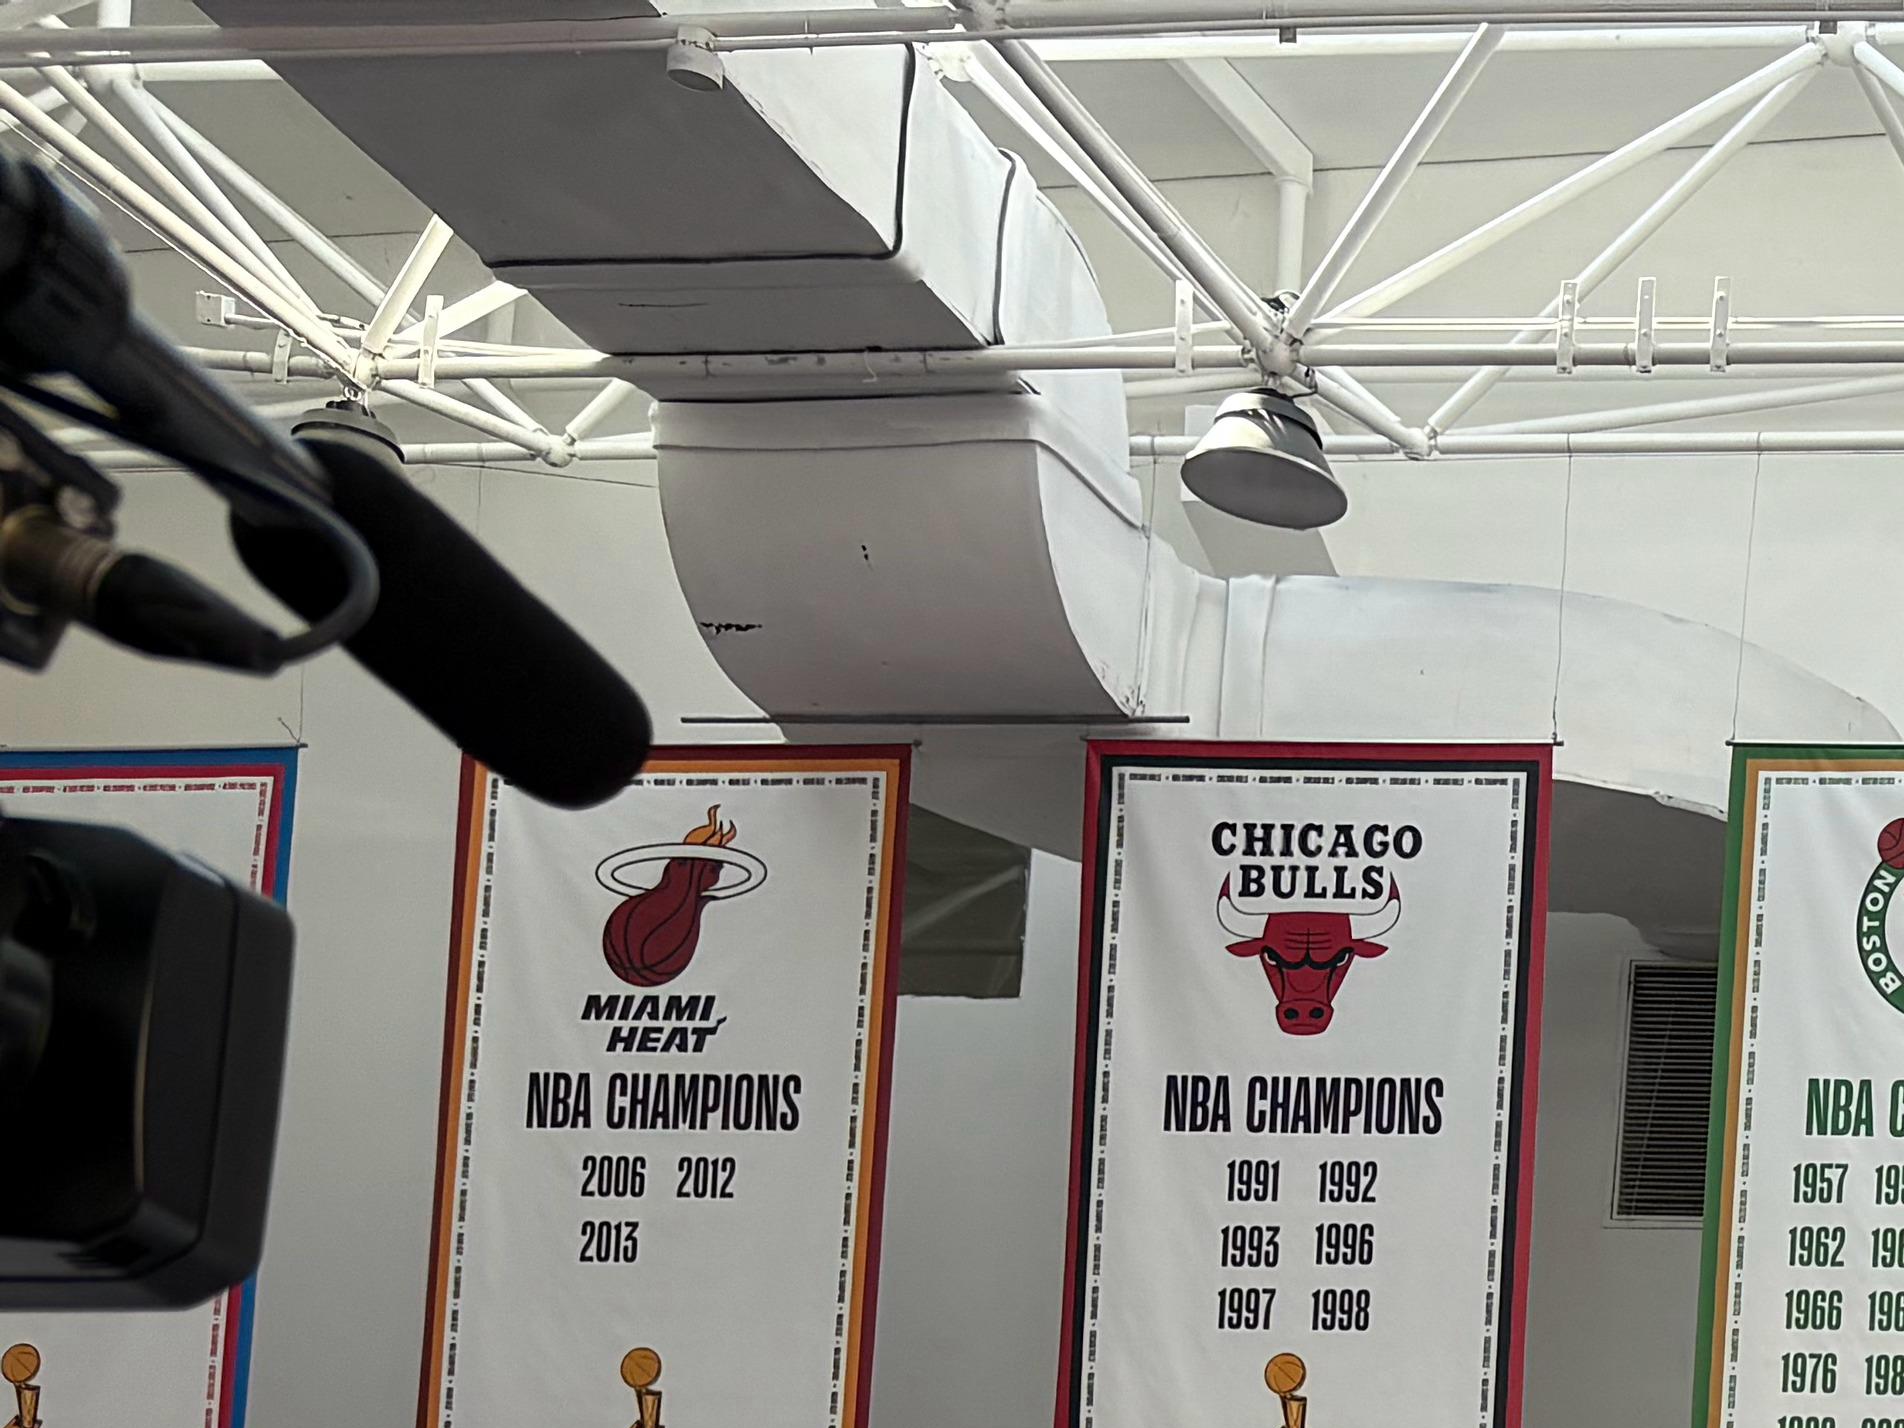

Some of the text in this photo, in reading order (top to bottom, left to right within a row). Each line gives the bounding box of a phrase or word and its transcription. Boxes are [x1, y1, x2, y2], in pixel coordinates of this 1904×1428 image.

[1210, 821, 1423, 859] CHICAGO
[1237, 865, 1386, 900] BULLS
[1863, 868, 1900, 998] BOSTON
[581, 994, 717, 1022] MIAMI
[606, 1018, 727, 1053] HEAT
[525, 1071, 802, 1132] NBA CHAMPIONS
[1163, 1074, 1444, 1135] NBA CHAMPIONS
[1805, 1077, 1874, 1138] NBA
[580, 1155, 736, 1199] 2006 2012
[1226, 1159, 1378, 1203] 1991 1992
[1792, 1162, 1849, 1204] 1957
[579, 1220, 640, 1263] 2013
[1220, 1222, 1375, 1268] 1993 1996
[1788, 1225, 1846, 1268] 1962
[1217, 1287, 1371, 1332] 1997 1998
[1785, 1289, 1843, 1331] 1966
[1781, 1352, 1838, 1394] 1976
